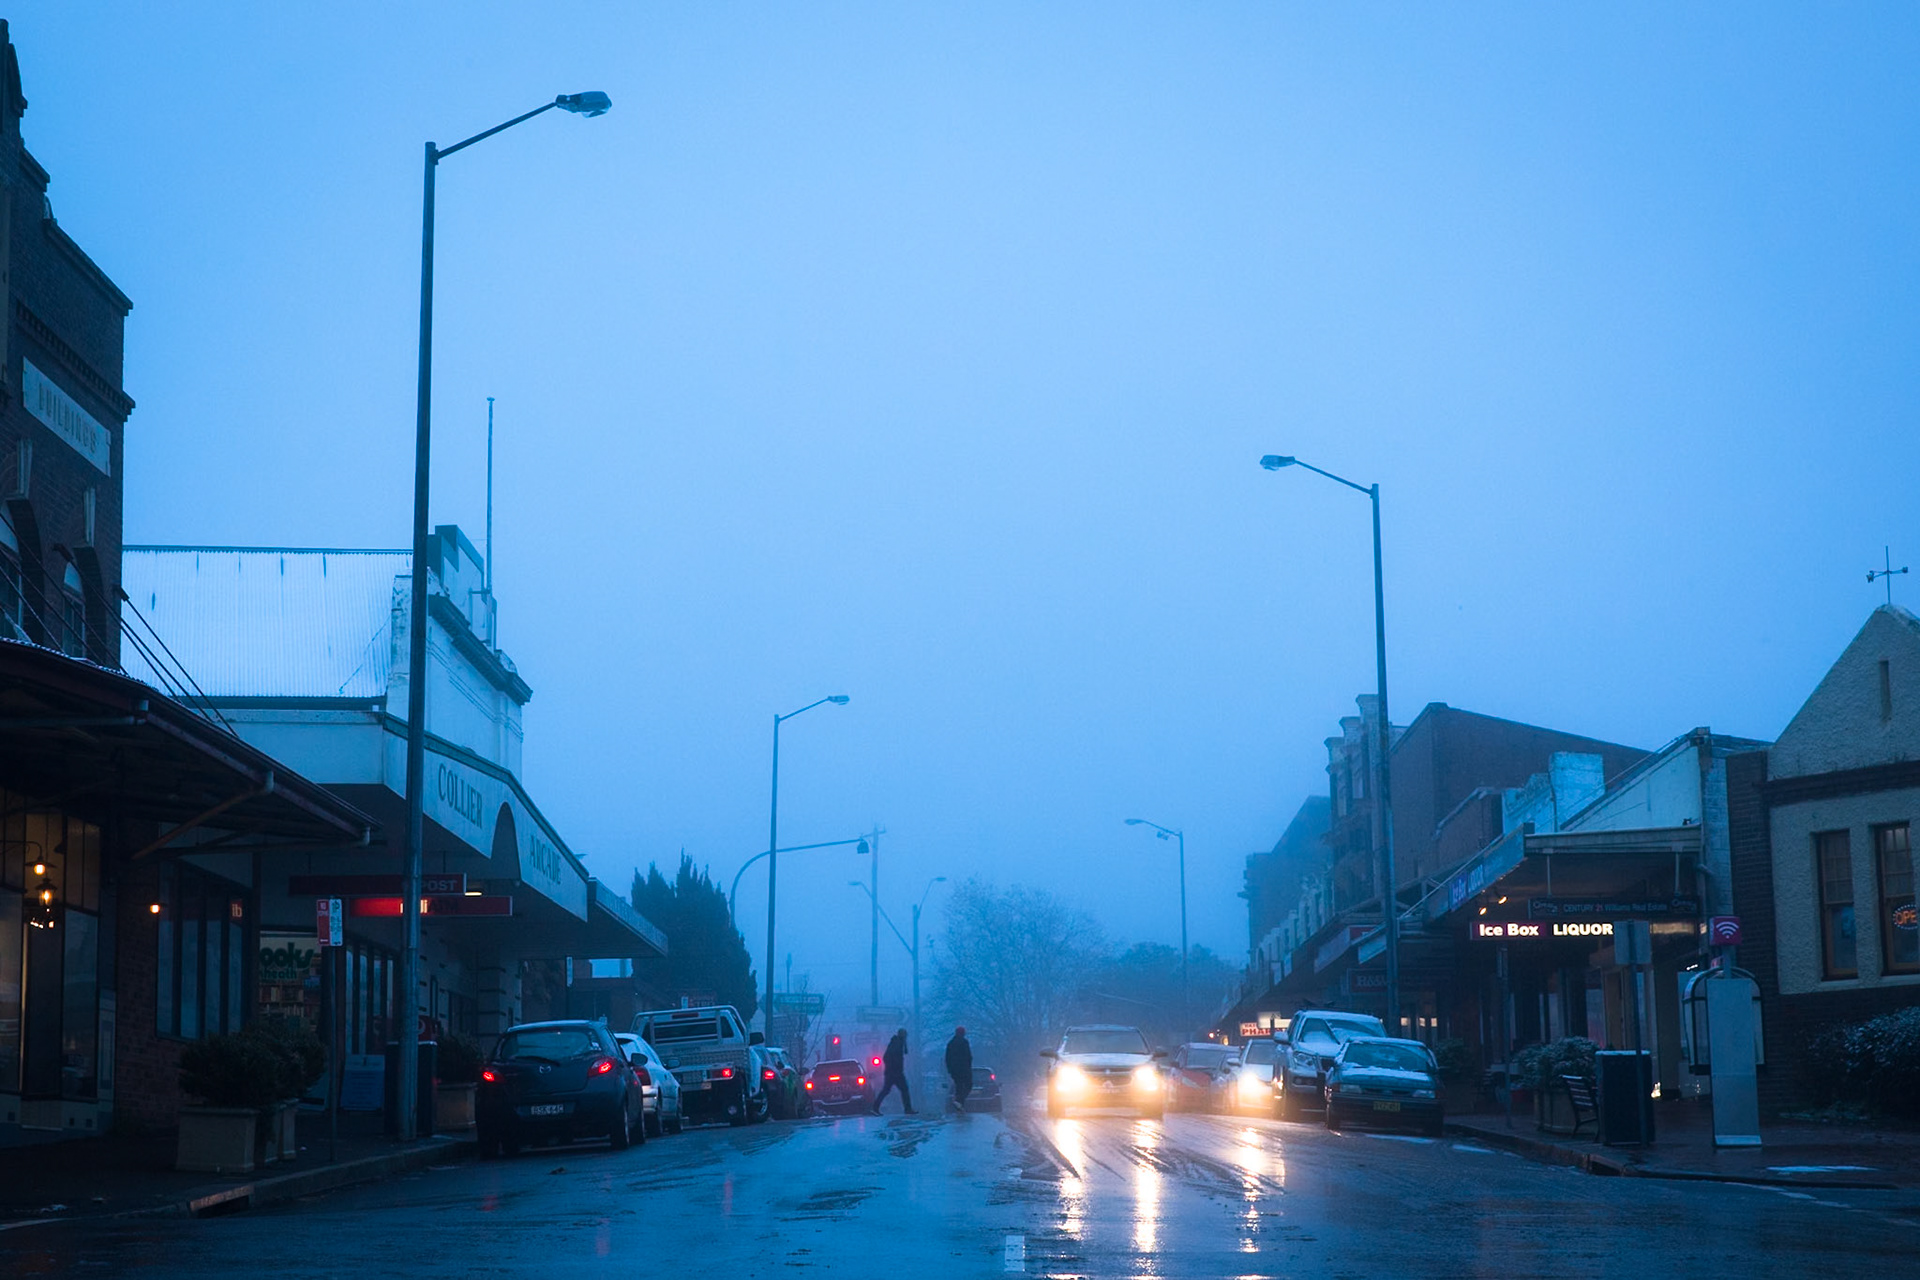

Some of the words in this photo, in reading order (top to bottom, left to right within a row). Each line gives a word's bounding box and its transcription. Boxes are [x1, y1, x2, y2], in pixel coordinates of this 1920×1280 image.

[438, 763, 483, 829] COLLIER
[529, 834, 561, 885] ARCADE
[1563, 903, 1594, 912] CENTURY
[1632, 903, 1646, 912] Real
[1647, 903, 1667, 912] Estate
[1895, 909, 1918, 925] OPE
[1479, 923, 1503, 936] Ice
[1507, 923, 1539, 936] Box
[1552, 923, 1613, 936] LIQUOR
[260, 942, 314, 969] ooks
[261, 966, 297, 980] heath
